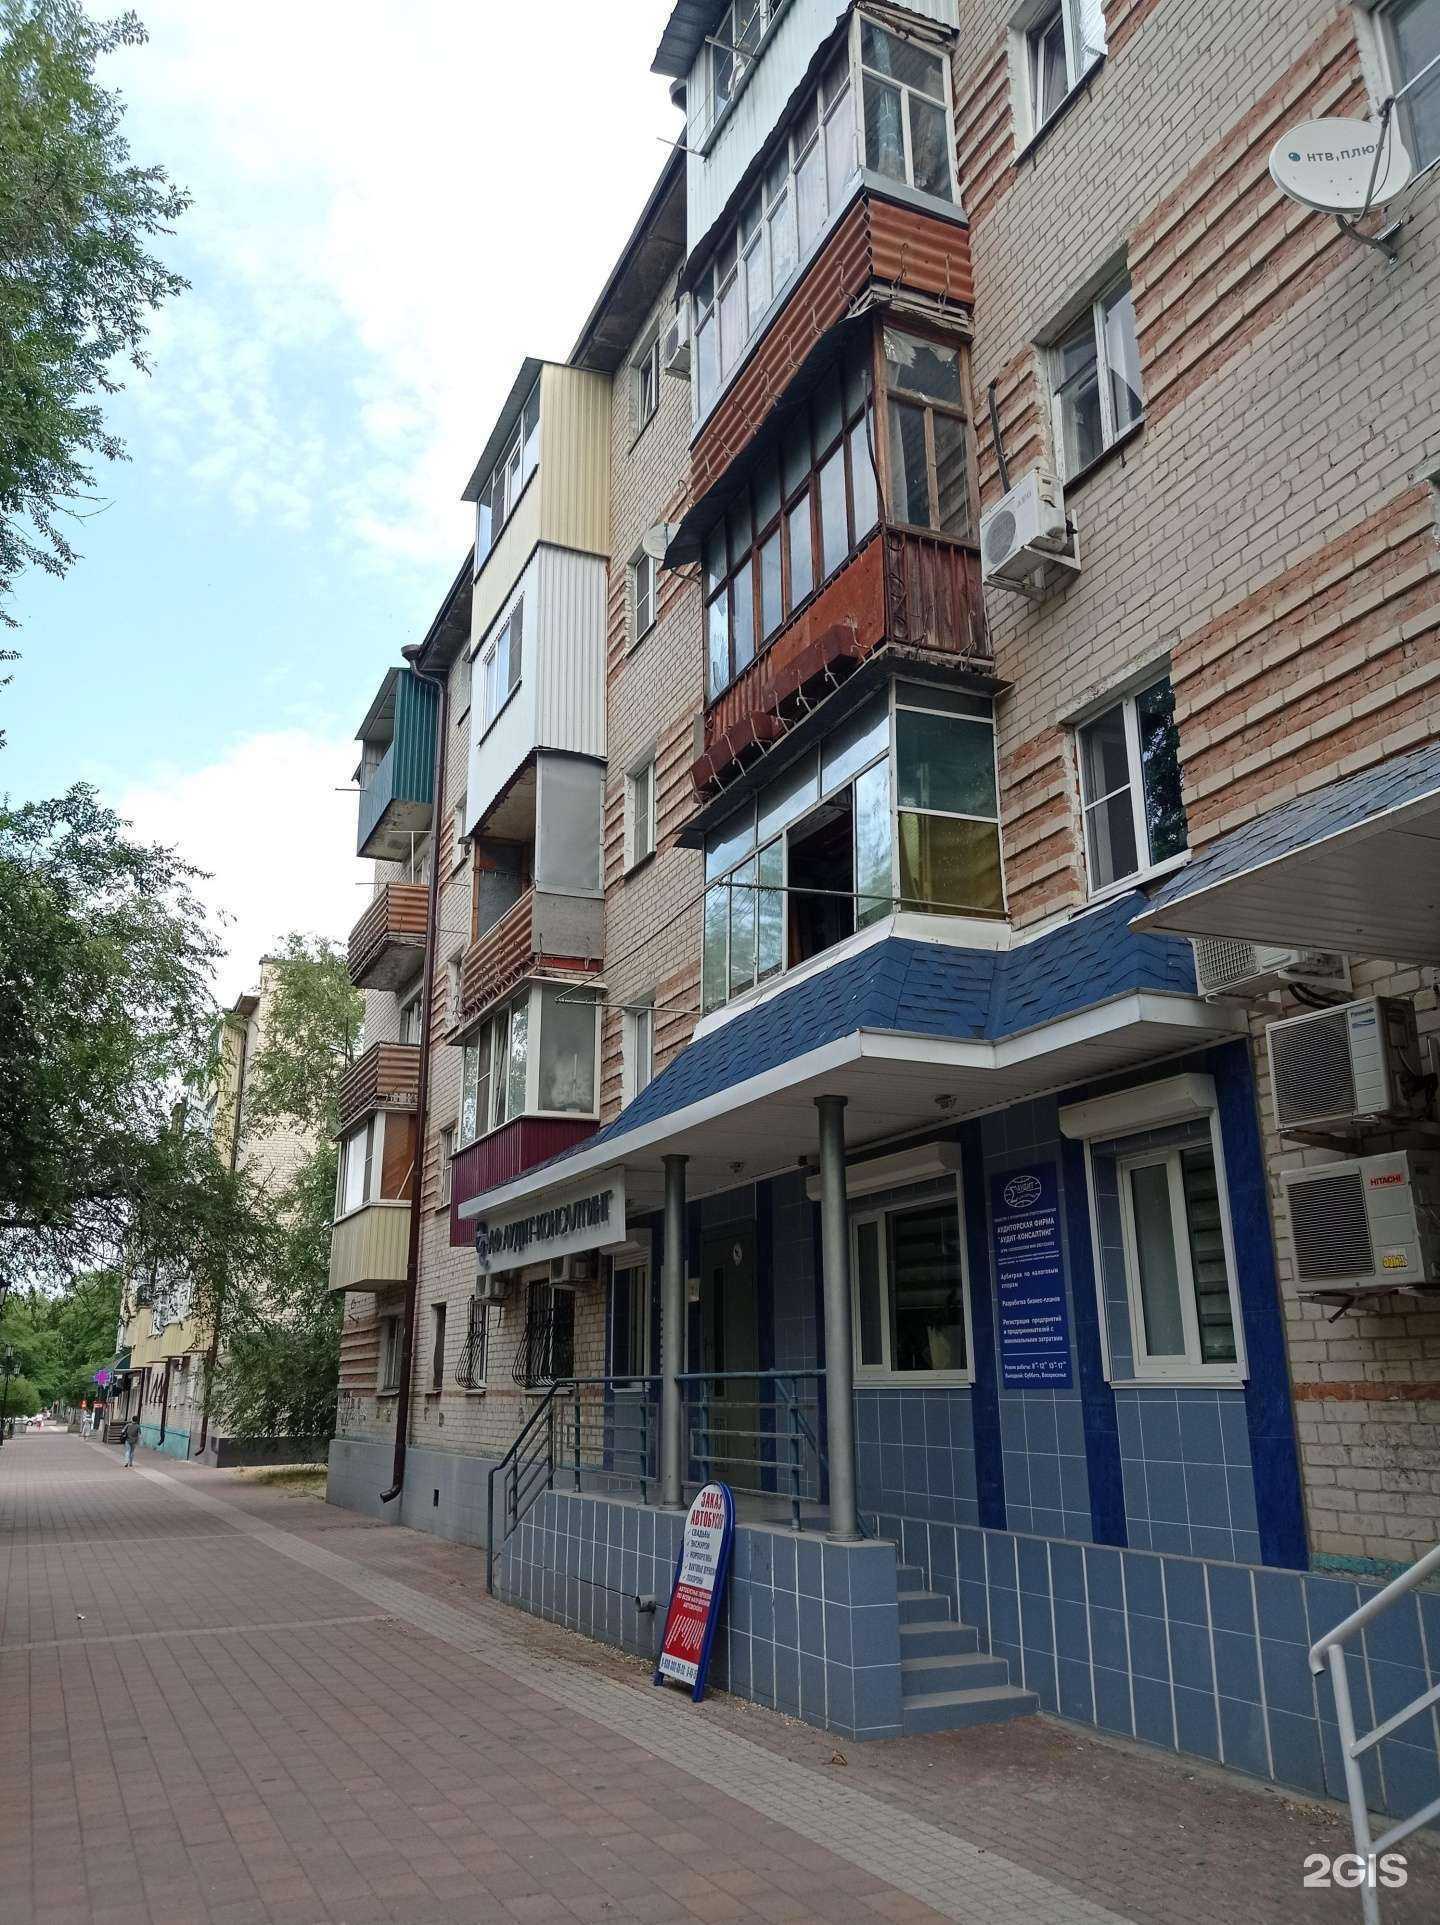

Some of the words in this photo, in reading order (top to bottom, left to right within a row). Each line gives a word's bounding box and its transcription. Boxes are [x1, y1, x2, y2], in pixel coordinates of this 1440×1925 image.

[1370, 1175, 1401, 1185] HITACHI
[997, 1221, 1033, 1233] АУДИТОРСКАЯ
[1034, 1217, 1055, 1227] ФИРМА
[701, 1492, 723, 1510] ЗАКАЗ
